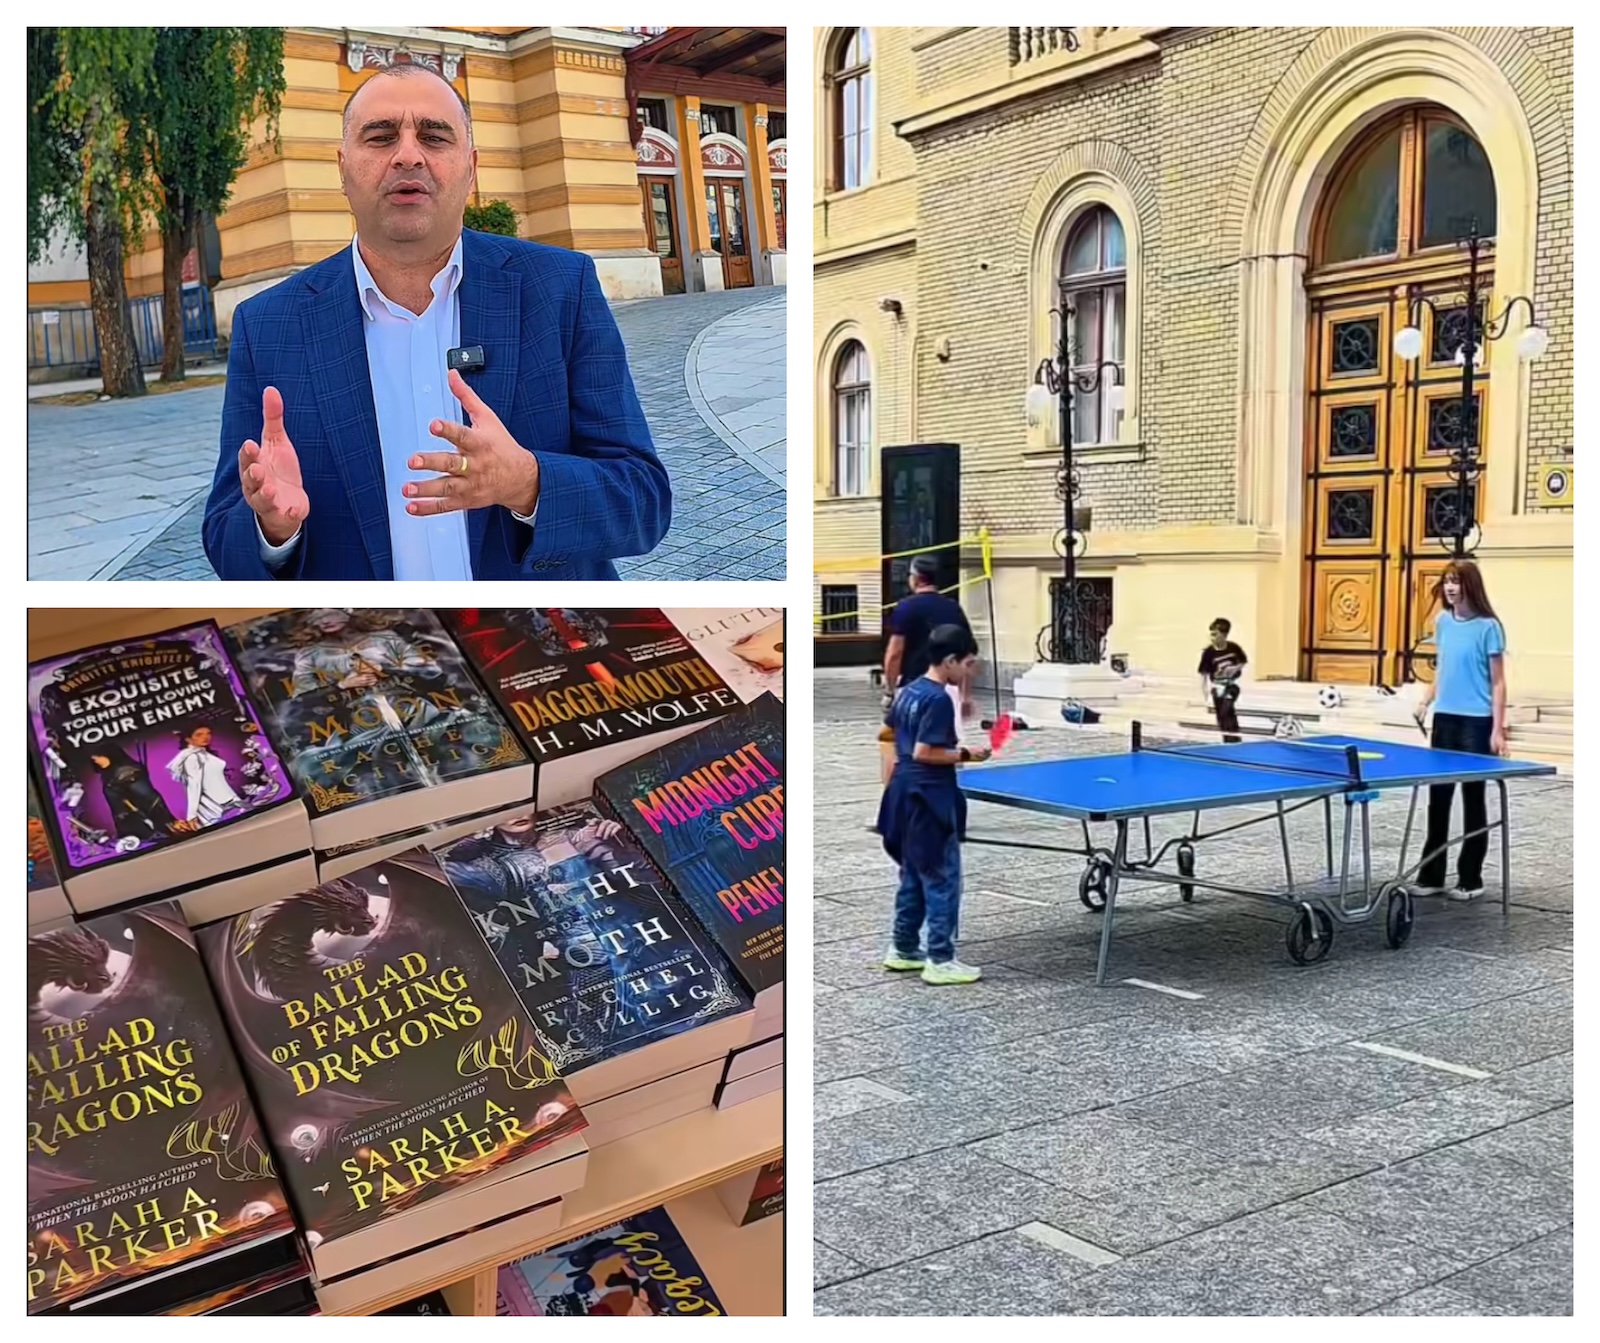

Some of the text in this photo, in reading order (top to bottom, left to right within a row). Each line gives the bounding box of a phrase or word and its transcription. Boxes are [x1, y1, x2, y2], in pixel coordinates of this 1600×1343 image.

[62, 702, 137, 732] TORMENT
[155, 679, 212, 704] LOVING
[68, 666, 199, 715] EXQUISITE
[120, 672, 140, 684] THE
[510, 657, 721, 732] DAGGERMOUTH
[66, 717, 139, 749] YOUR
[142, 690, 217, 726] ENEMY
[305, 687, 463, 743] MOON
[532, 687, 738, 754] H. M. WOLFE
[631, 741, 780, 835] MIDNIGHT
[475, 862, 640, 938] KNIGHT
[323, 957, 366, 983] THE
[517, 916, 672, 989] MOTH
[536, 1002, 555, 1012] THE
[555, 995, 571, 1006] NO.
[578, 970, 643, 997] INTERNATIONAL
[643, 953, 692, 973] BESTSELLER
[271, 965, 469, 1064] OF FALLING
[281, 951, 428, 1030] BALLAD
[541, 961, 704, 1028] RACHEL
[566, 985, 709, 1044] GILLIG
[42, 1018, 89, 1042] THE
[287, 996, 483, 1096] DRAGONS
[28, 1038, 193, 1110] ALLING
[340, 1099, 515, 1183] SARAH A.
[341, 1076, 489, 1143] INTERNATIONAL BESTSELLING AUTHOR OF
[351, 1085, 486, 1148] WHEN THE MOON HATCHED
[94, 1176, 157, 1199] BESTSELLING
[158, 1162, 200, 1179] AUTHOR
[200, 1157, 212, 1166] OF
[348, 1115, 532, 1212] PARKER
[35, 1170, 197, 1231] WHEN THE MOON HATCHED
[181, 1186, 217, 1213] A.
[28, 1208, 228, 1301] PARKER
